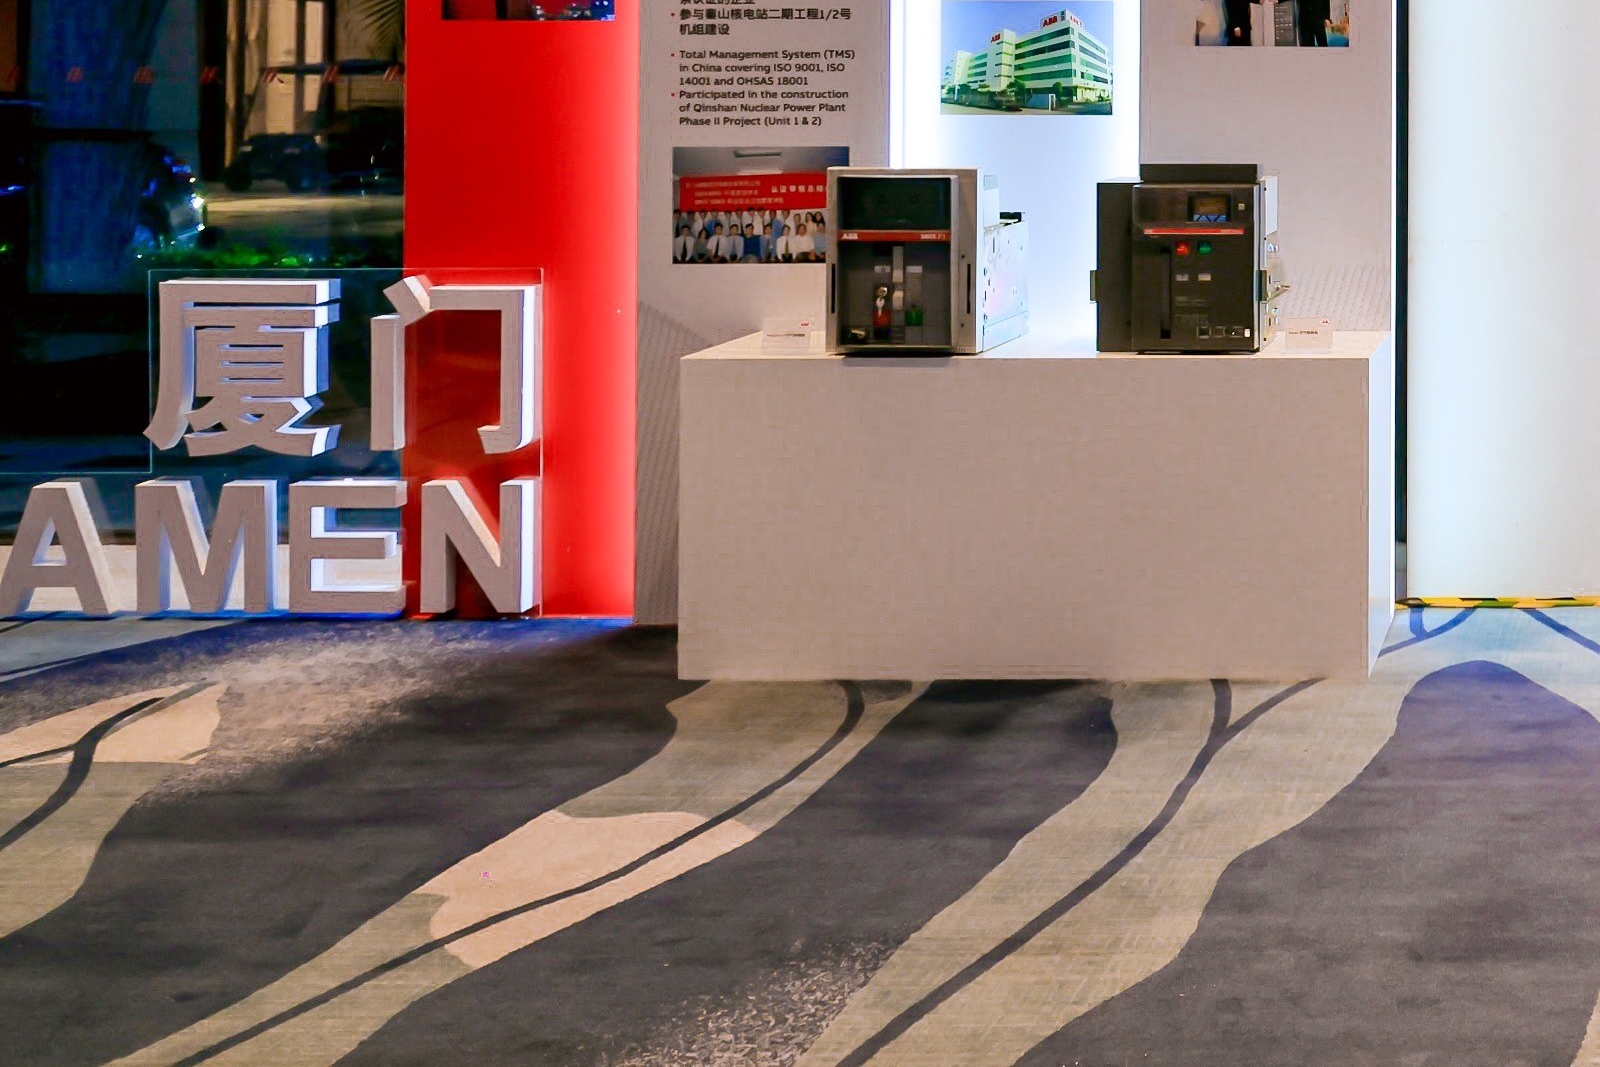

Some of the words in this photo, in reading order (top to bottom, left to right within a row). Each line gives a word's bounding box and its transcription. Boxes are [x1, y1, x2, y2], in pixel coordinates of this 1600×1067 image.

[680, 50, 706, 58] Total
[710, 51, 778, 61] Management
[782, 50, 820, 60] System
[824, 50, 855, 59] (TMS)
[143, 277, 543, 456] 厦门
[0, 479, 542, 614] AMEN
